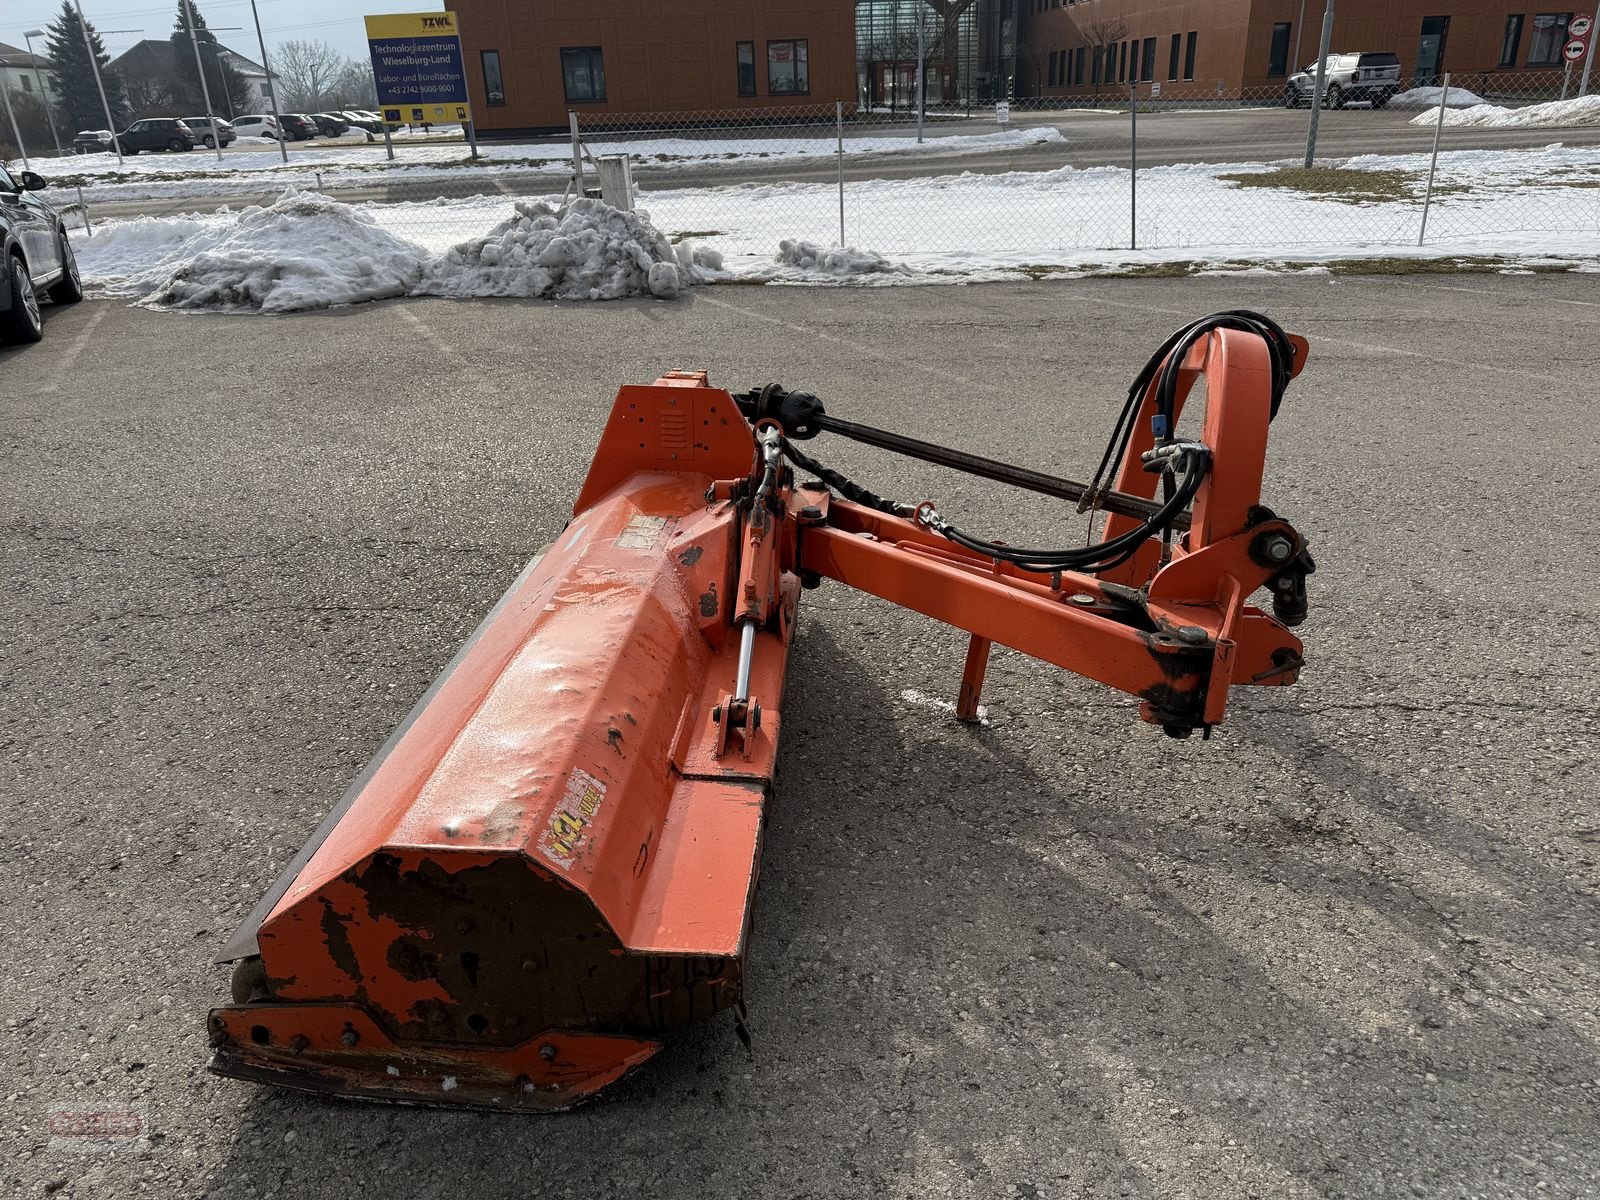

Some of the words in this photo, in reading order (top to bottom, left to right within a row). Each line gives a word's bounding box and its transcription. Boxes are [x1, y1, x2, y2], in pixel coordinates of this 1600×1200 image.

[421, 16, 453, 27] TZWL
[373, 43, 456, 54] Technologiezentrum
[382, 54, 451, 66] Wieselburg-Land
[379, 75, 401, 83] Labor-
[402, 74, 417, 82] und
[418, 72, 460, 81] Büroflächen
[388, 86, 400, 94] +43
[420, 84, 455, 93] 9000-9001
